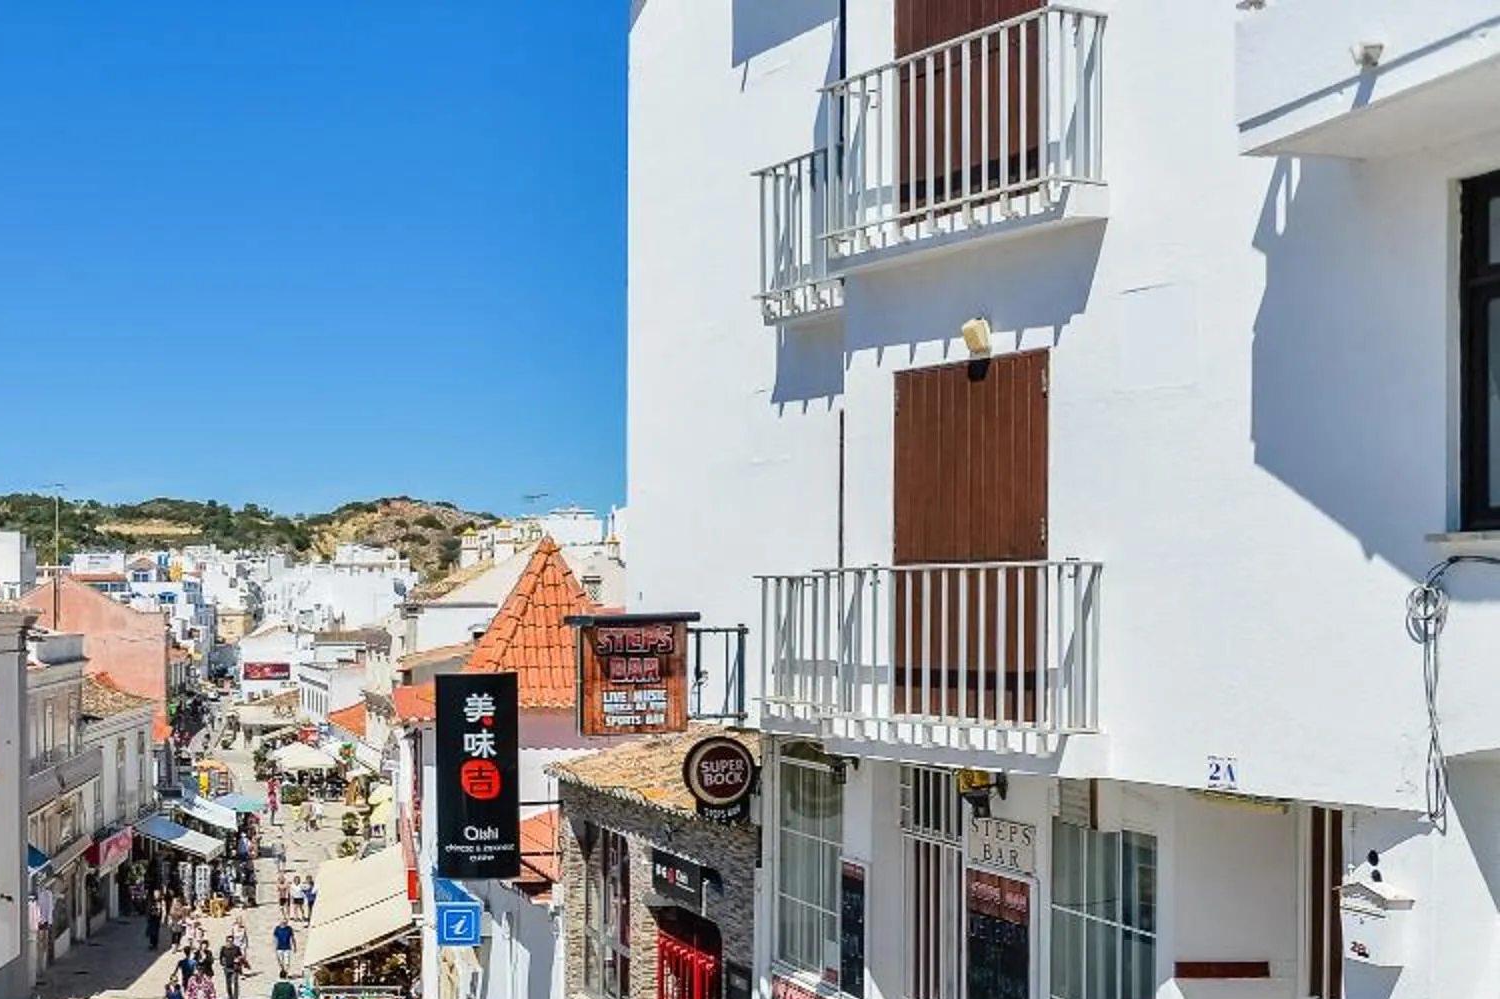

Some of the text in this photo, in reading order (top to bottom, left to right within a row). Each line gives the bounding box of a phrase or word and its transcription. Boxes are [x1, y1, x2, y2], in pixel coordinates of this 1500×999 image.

[597, 625, 674, 653] STEPS
[610, 657, 661, 684] BAR
[603, 691, 627, 703] LIVE
[701, 759, 745, 774] SUPER
[703, 771, 743, 788] BOCK
[463, 825, 499, 841] Oishi
[971, 818, 1031, 847] STEPS
[983, 843, 1020, 869] BAR
